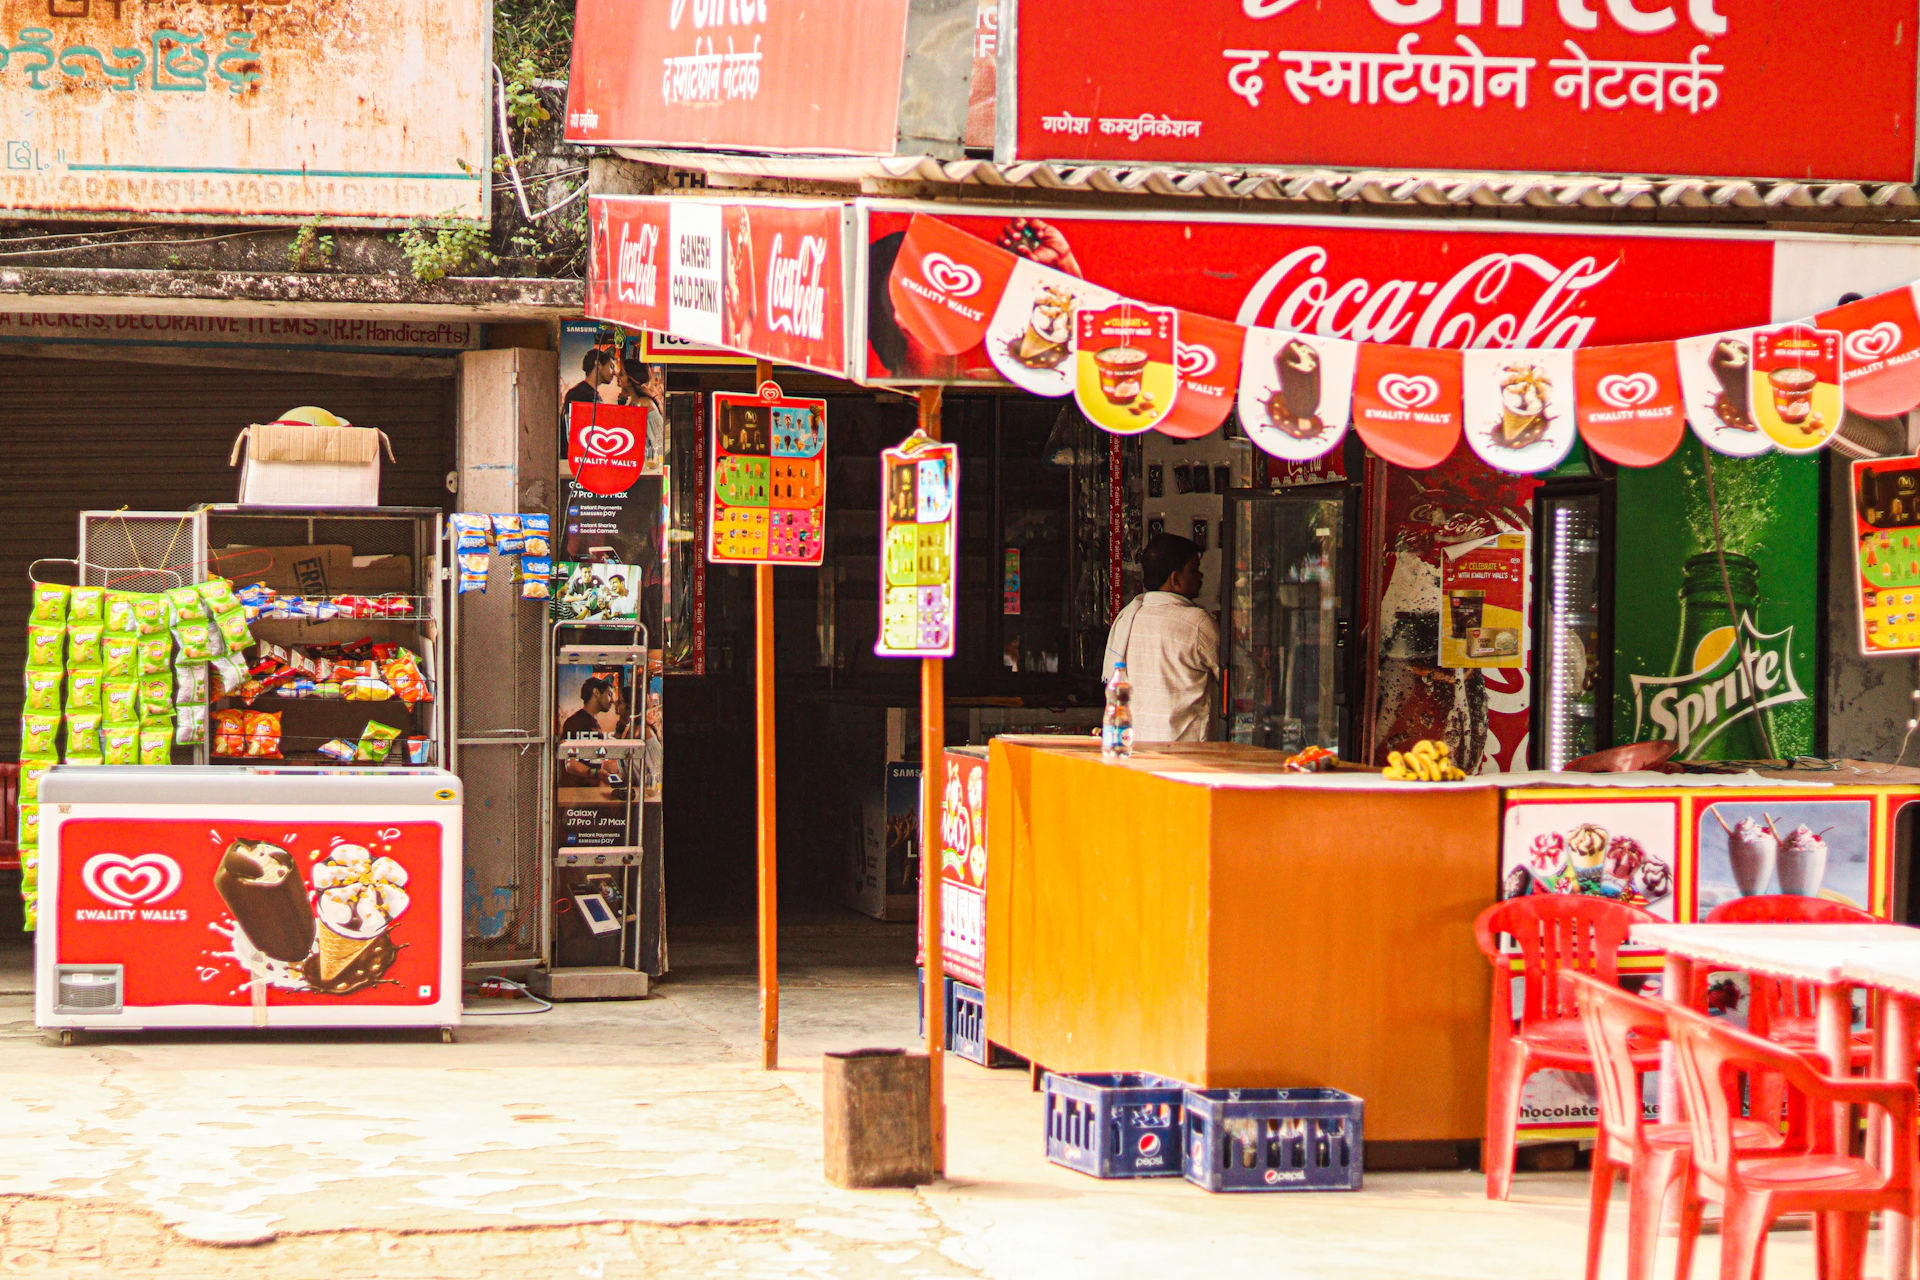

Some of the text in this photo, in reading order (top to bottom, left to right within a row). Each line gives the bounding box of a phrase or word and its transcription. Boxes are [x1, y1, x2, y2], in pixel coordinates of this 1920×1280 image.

[1223, 33, 1725, 114] द स्मार्टफोन नेटवर्क
[1041, 110, 1202, 142] गणेश कम्युनिकेशन
[680, 234, 711, 270] GANESH
[673, 273, 718, 314] COLD DRINK
[901, 276, 985, 322] KWALITY WALL'S
[1235, 245, 1620, 350] Coca-Cola
[115, 314, 240, 332] DECORATIVE
[1843, 347, 1920, 381] KWALITY WALL'S
[1186, 379, 1226, 396] WALL'S
[1364, 408, 1450, 423] KWALITY WALL'S
[1589, 405, 1672, 422] KWALITY WALL'S
[574, 456, 637, 468] KWALITY WALL'S
[1468, 562, 1498, 571] CELEBRATE
[1650, 637, 1782, 754] Sprite
[566, 808, 597, 819] Galaxy
[566, 818, 626, 826] J7 Pro J7 Max
[75, 909, 188, 921] KWALITY WALL'S
[1517, 1103, 1599, 1119] hocolate
[1135, 1155, 1163, 1168] pepsi
[1276, 1170, 1305, 1182] pepsi
